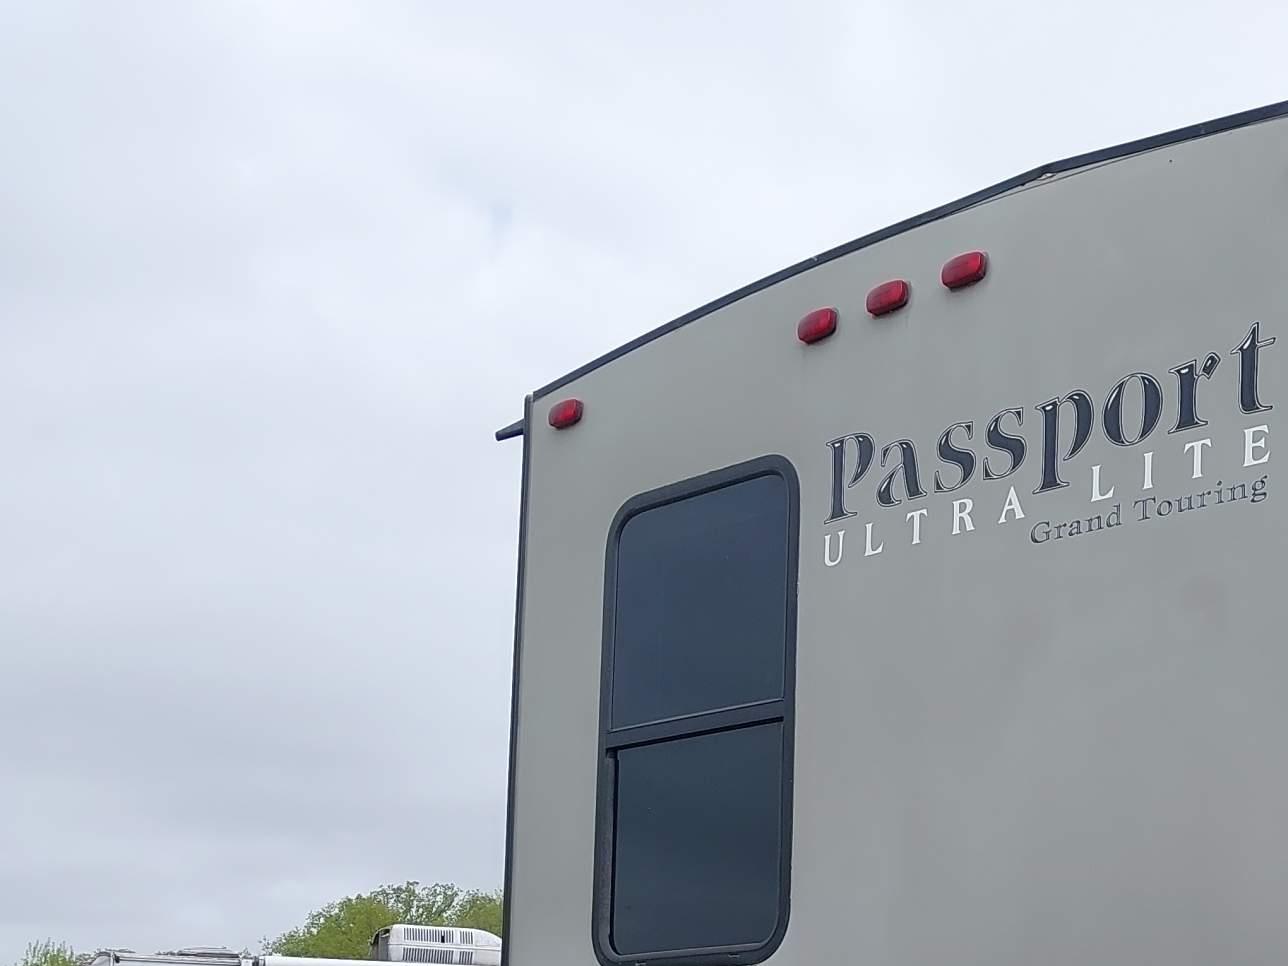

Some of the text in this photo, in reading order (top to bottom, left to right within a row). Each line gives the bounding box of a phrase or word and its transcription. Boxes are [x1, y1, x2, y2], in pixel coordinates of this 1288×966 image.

[823, 321, 1276, 526] Passport
[823, 424, 1271, 567] ULTRA LITE
[1030, 474, 1269, 545] Grand Touring
